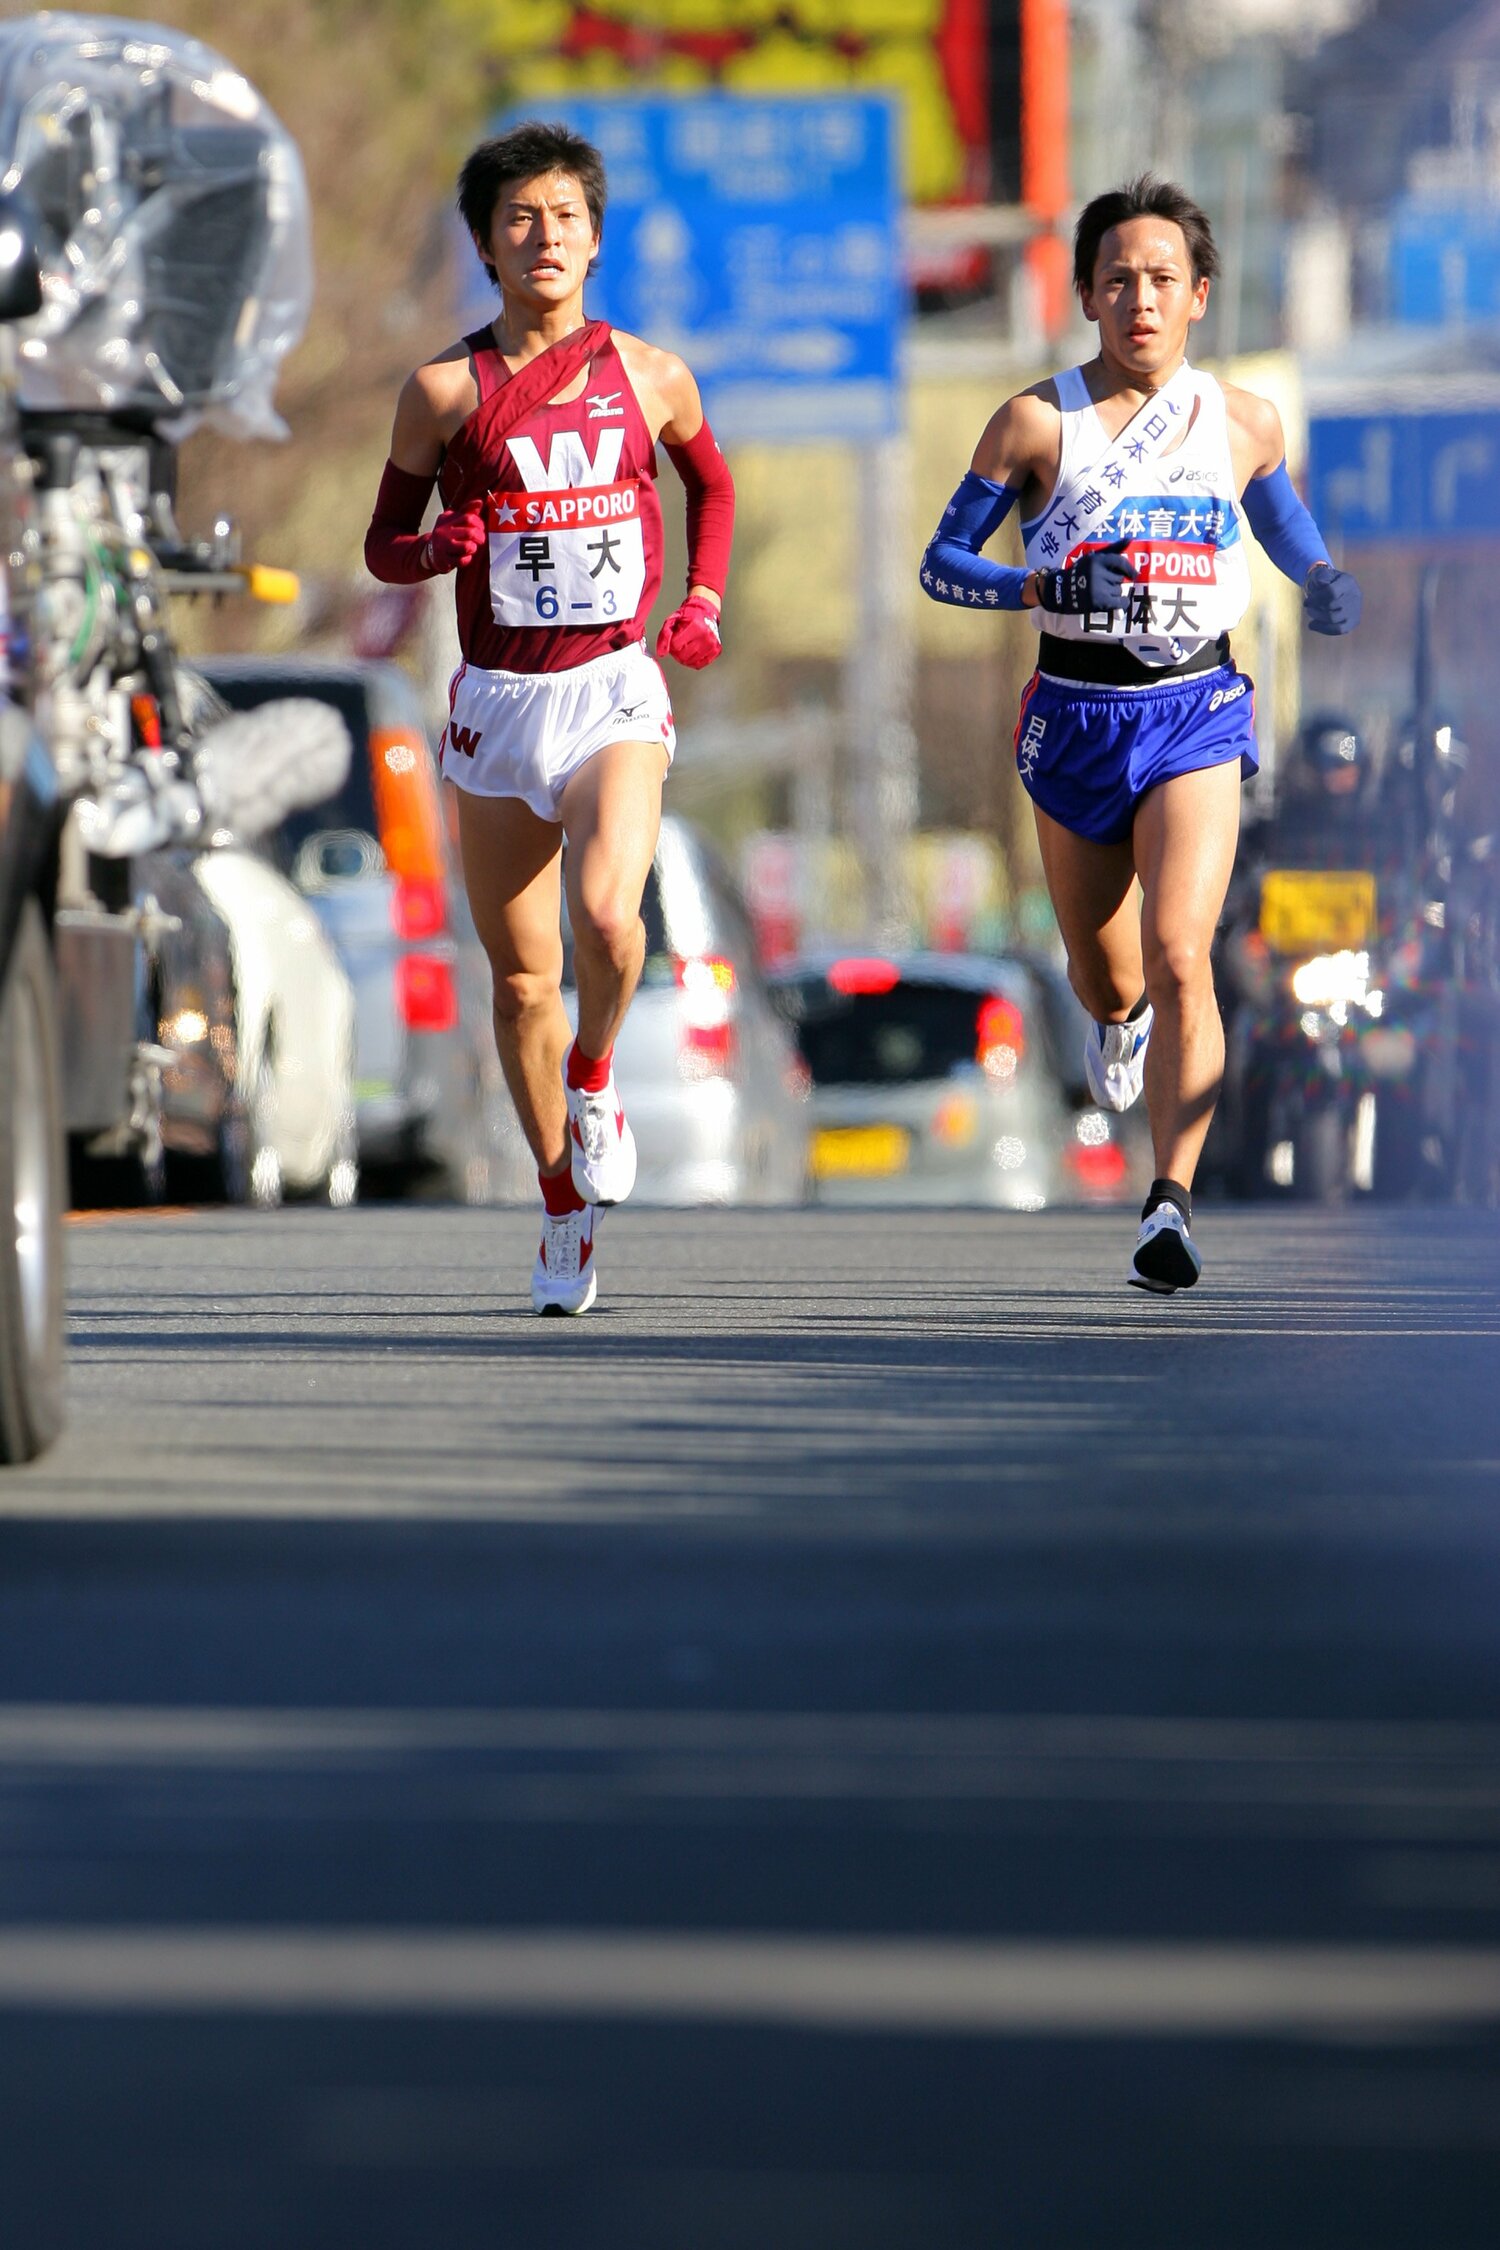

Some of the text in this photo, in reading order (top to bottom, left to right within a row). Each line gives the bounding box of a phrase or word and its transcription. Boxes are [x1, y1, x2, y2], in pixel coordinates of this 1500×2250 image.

[505, 428, 626, 493] W
[1040, 414, 1167, 558] 日本体育大学
[526, 489, 635, 525] SAPPORO
[1093, 508, 1226, 539] 本体育大学
[515, 529, 622, 582] 早大
[1121, 551, 1212, 578] PPORO
[922, 568, 999, 605] 本体育大学
[1223, 683, 1246, 704] asics
[450, 721, 482, 759] W
[1019, 715, 1047, 781] 日体大
